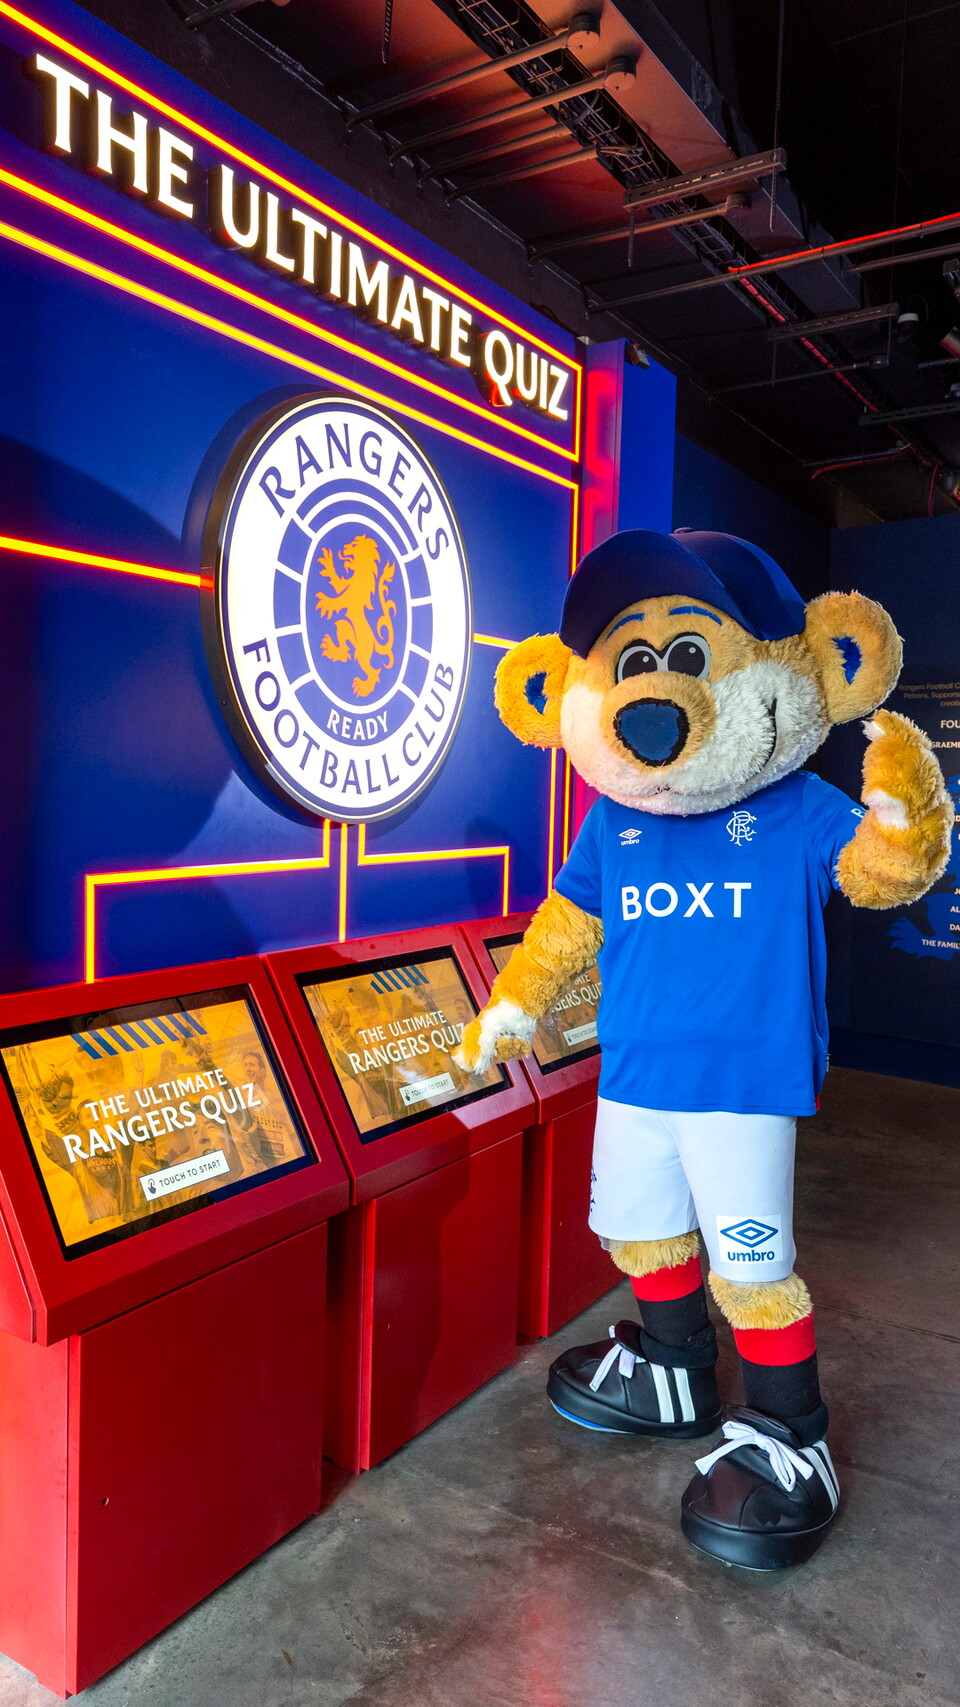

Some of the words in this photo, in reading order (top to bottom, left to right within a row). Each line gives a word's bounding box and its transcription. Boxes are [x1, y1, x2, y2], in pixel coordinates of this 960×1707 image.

[36, 53, 194, 219] THE
[221, 164, 472, 368] ULTIMATE
[484, 330, 569, 421] QUIZ
[258, 423, 450, 561] RANGERS
[927, 682, 954, 690] Football
[243, 637, 400, 795] FOOTBALL
[402, 662, 455, 768] CLUB
[327, 710, 390, 741] READY
[620, 838, 640, 846] umbro
[621, 882, 752, 921] BOXT
[921, 938, 936, 947] THE
[937, 940, 960, 949] FAMIL
[554, 989, 582, 1012] GERS
[358, 1026, 387, 1045] THE
[388, 1010, 447, 1037] ULTIMATE
[347, 1033, 430, 1075] RANGERS
[84, 1094, 130, 1121] THE
[134, 1068, 228, 1108] ULTIMATE
[62, 1101, 197, 1164] RANGERS
[200, 1082, 262, 1125] QUIZ
[159, 1172, 187, 1187] TOUCH
[187, 1167, 198, 1177] TO
[199, 1159, 222, 1174] START
[727, 1250, 775, 1262] umbro
